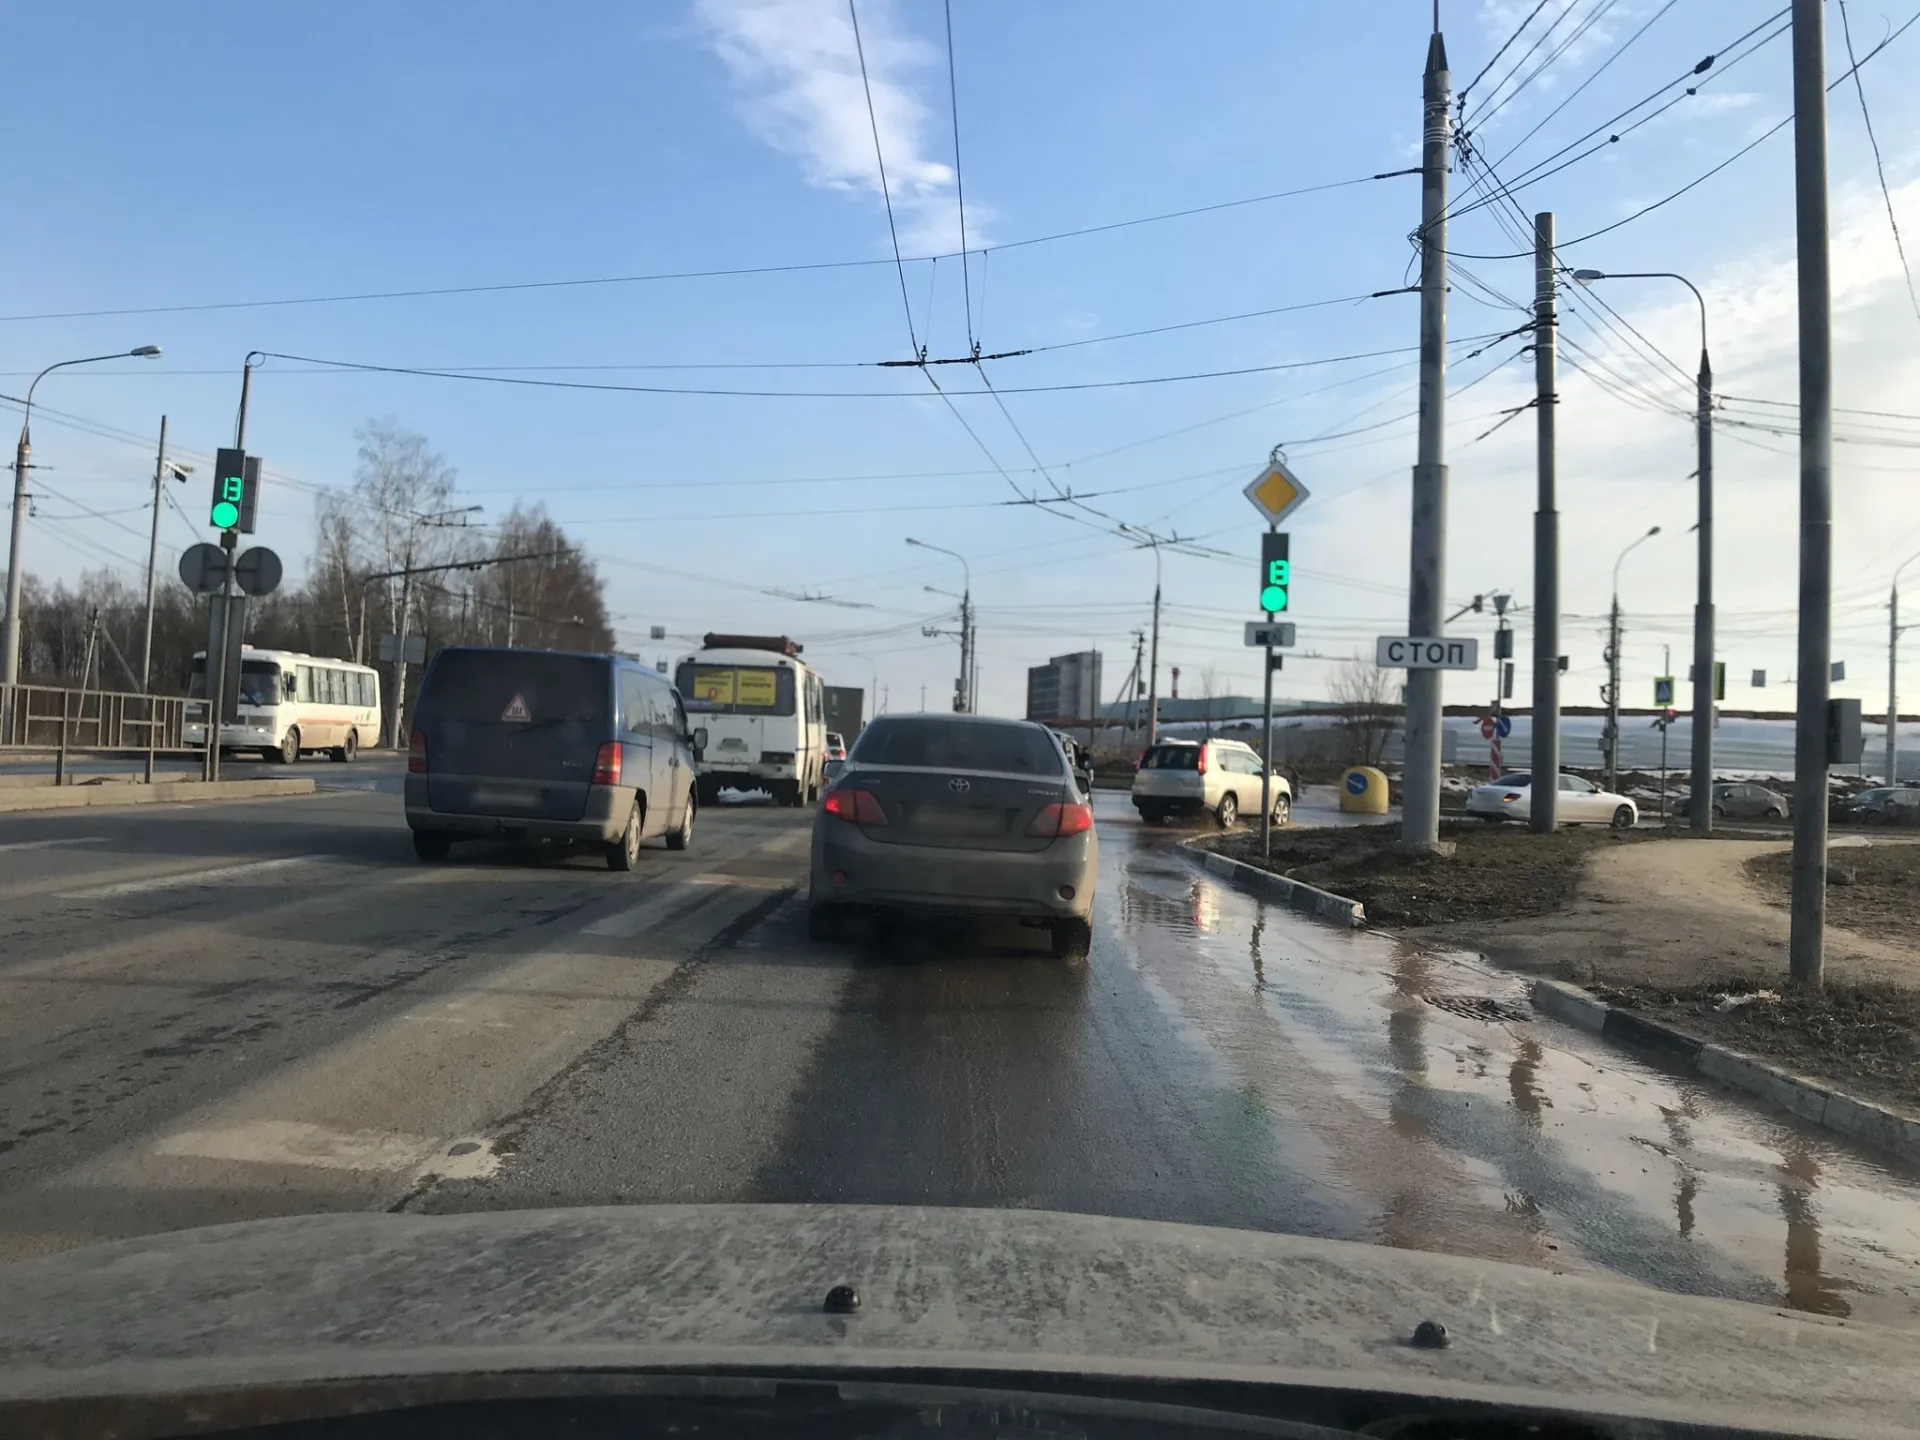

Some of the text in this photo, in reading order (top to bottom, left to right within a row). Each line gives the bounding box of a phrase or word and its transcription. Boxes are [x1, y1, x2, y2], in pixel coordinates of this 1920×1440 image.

[222, 477, 242, 502] 13
[1269, 559, 1289, 586] 13
[1388, 641, 1464, 665] СТОП
